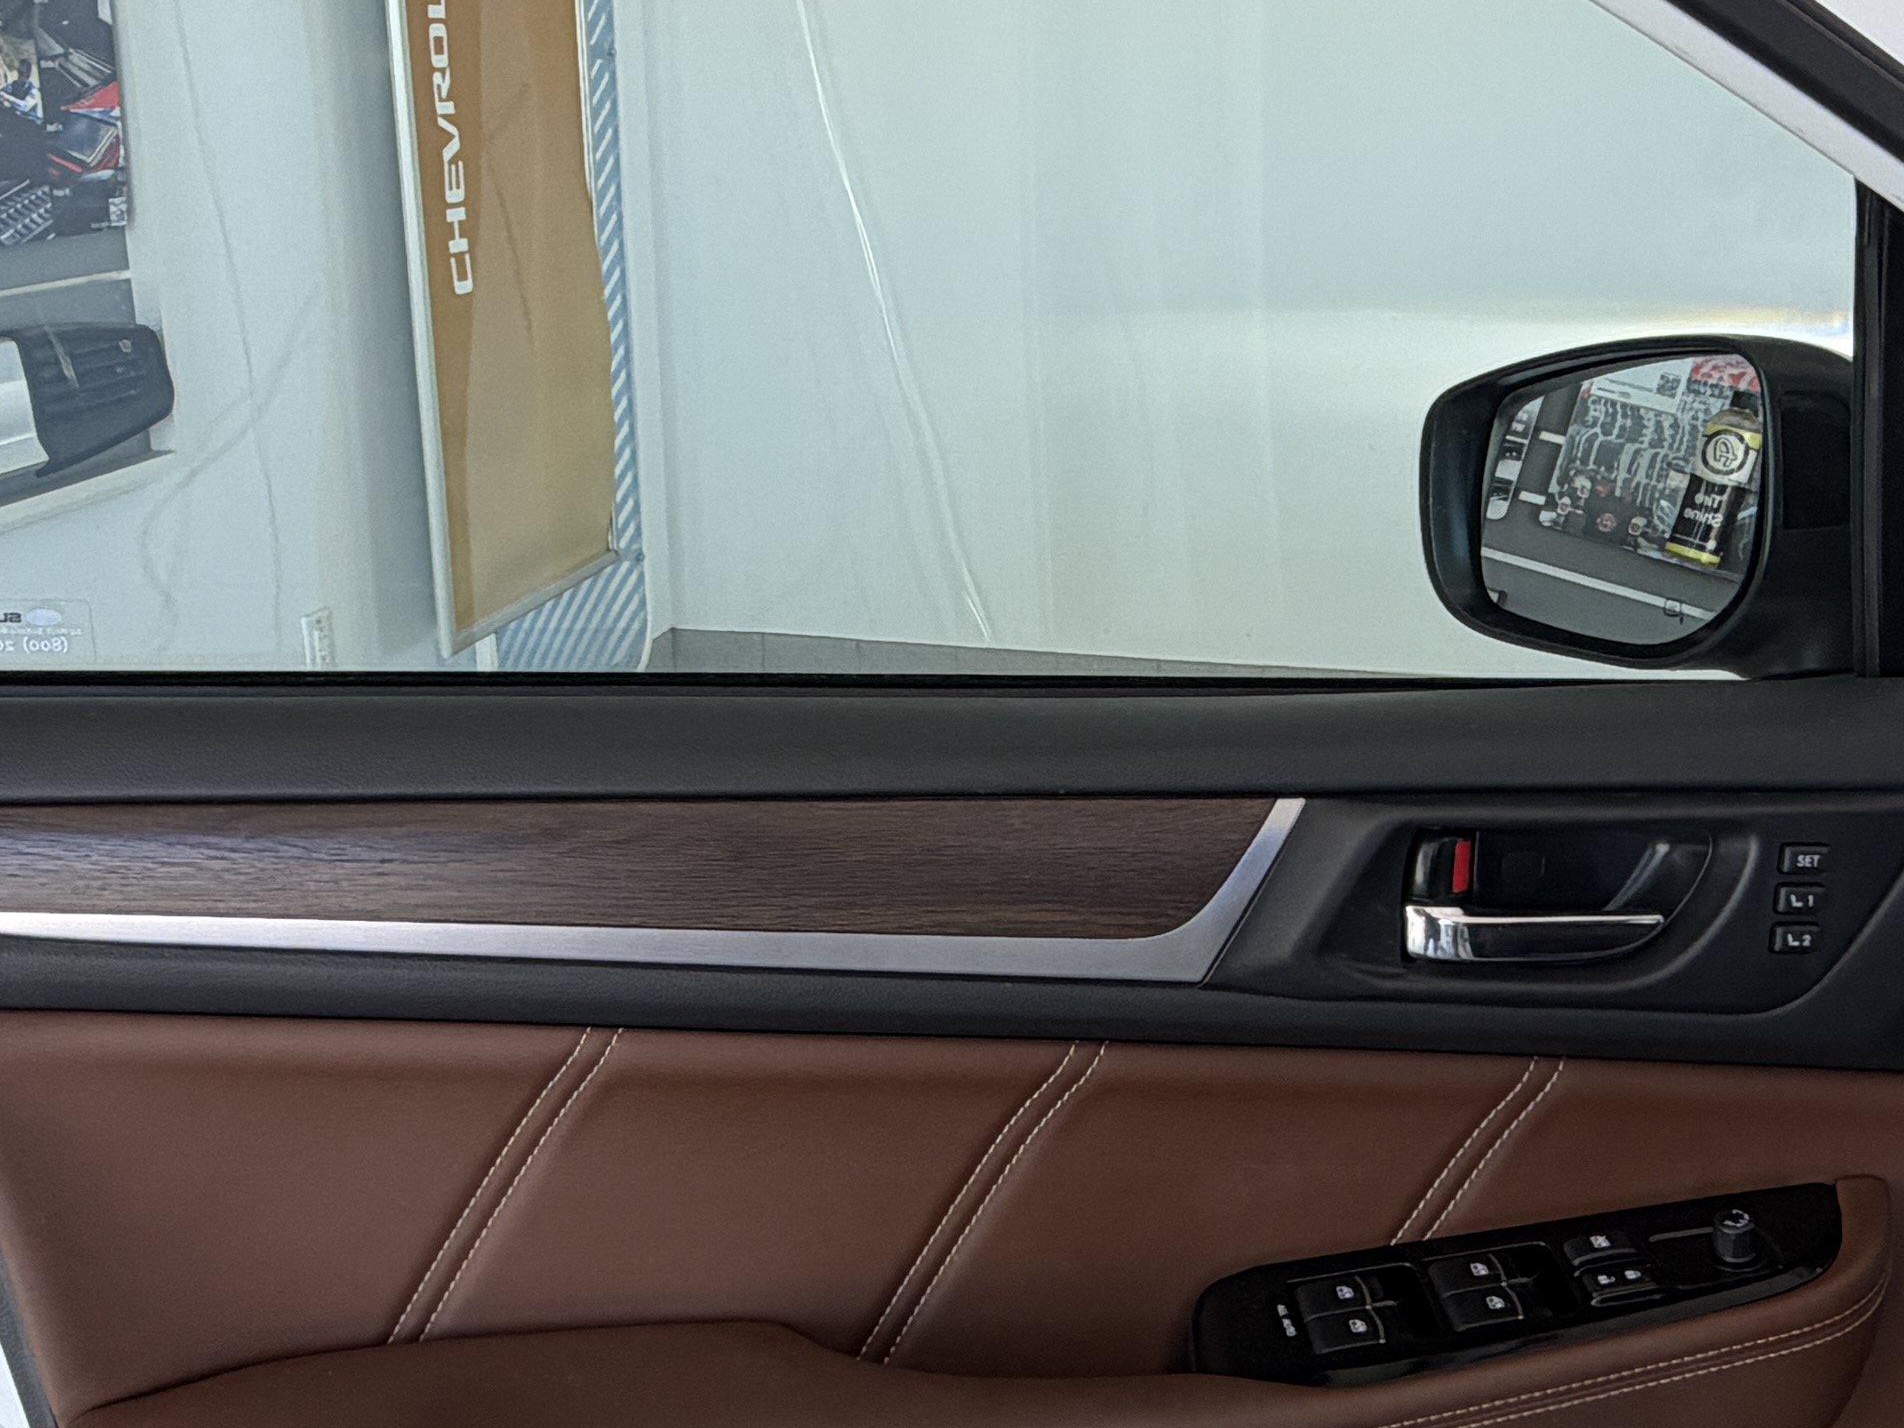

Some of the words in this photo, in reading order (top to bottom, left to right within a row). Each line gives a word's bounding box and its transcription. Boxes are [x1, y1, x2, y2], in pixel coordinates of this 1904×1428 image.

[1796, 853, 1821, 869] SET
[1806, 894, 1815, 908] 1
[1800, 934, 1813, 948] 2
